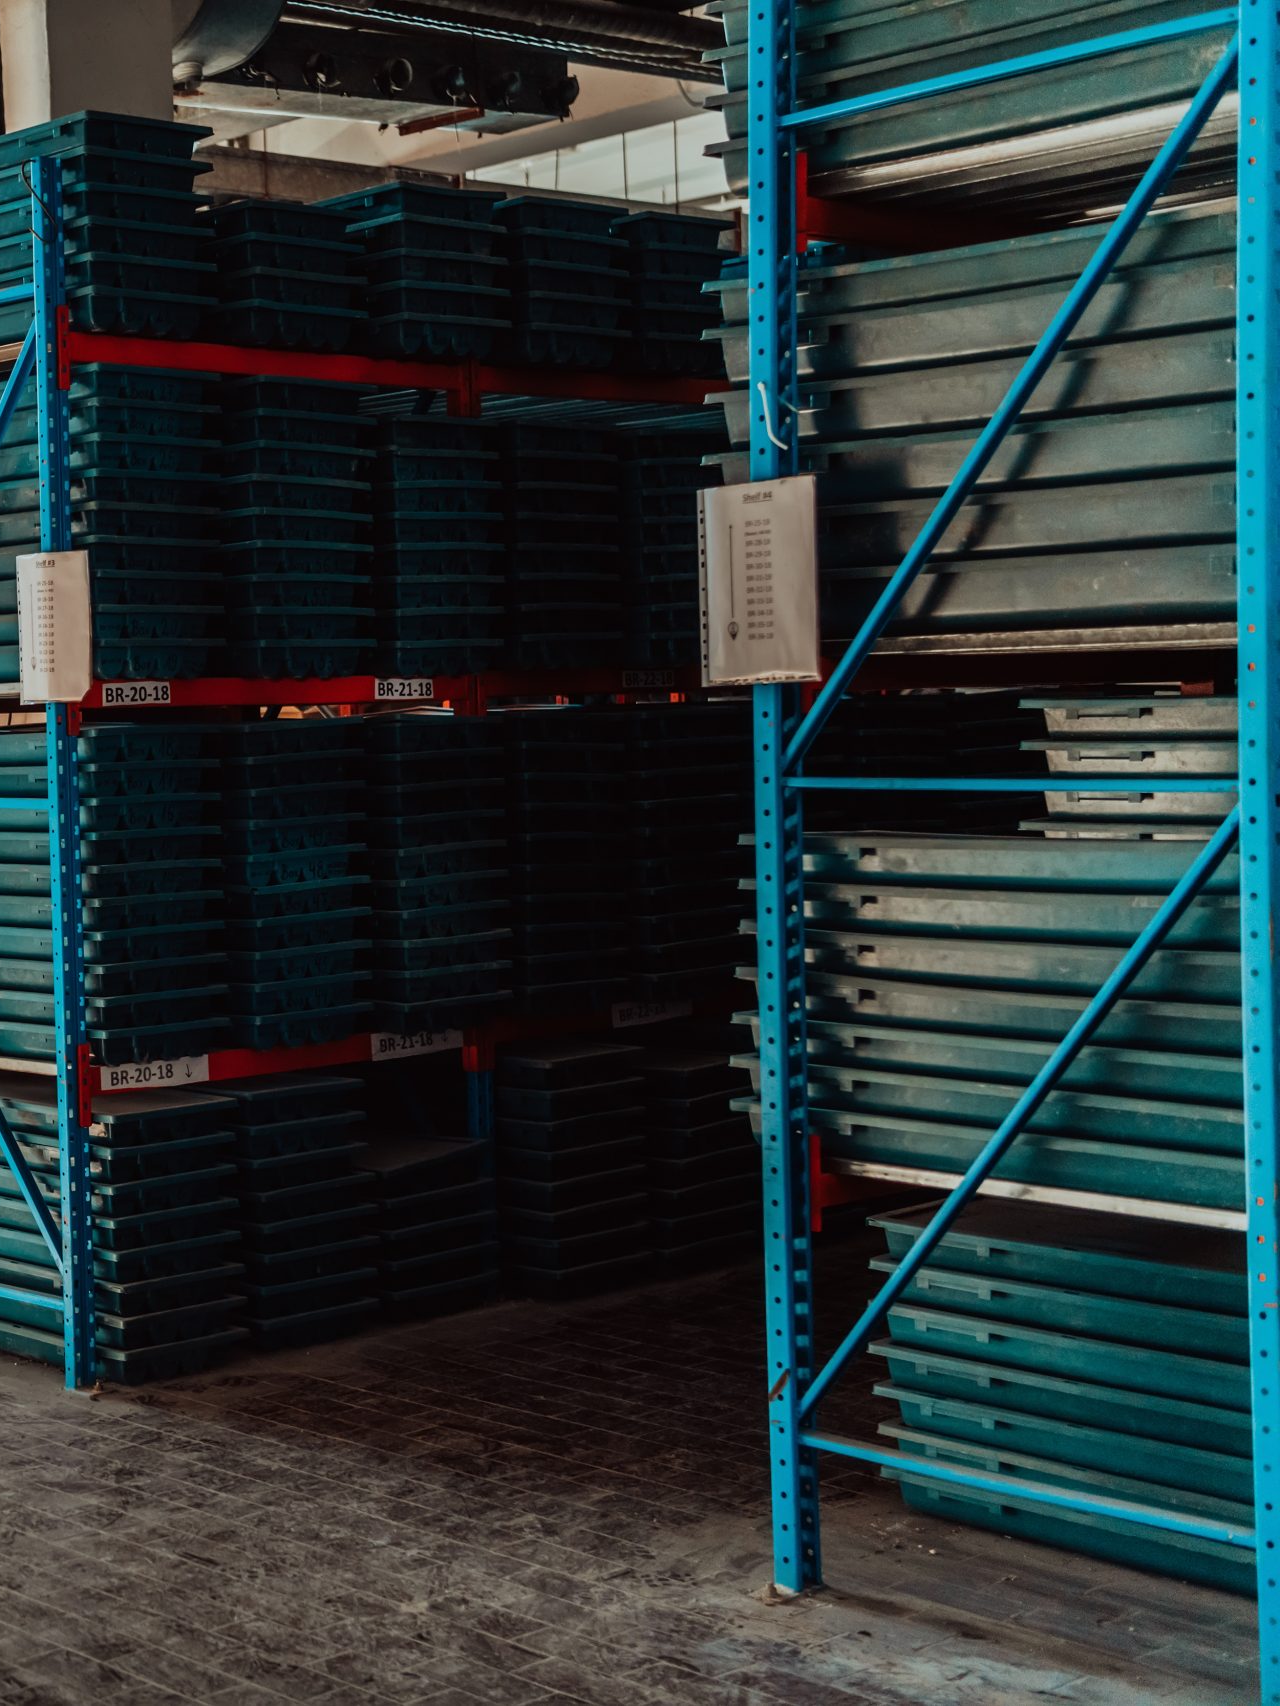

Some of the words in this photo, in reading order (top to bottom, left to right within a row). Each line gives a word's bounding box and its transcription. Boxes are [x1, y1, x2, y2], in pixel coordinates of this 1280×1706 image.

[742, 491, 761, 502] Shelf
[105, 685, 170, 704] BR-20-18
[377, 682, 433, 698] BR-21-18
[379, 1032, 434, 1053] BR-21-18
[110, 1063, 174, 1087] BR-20-18
